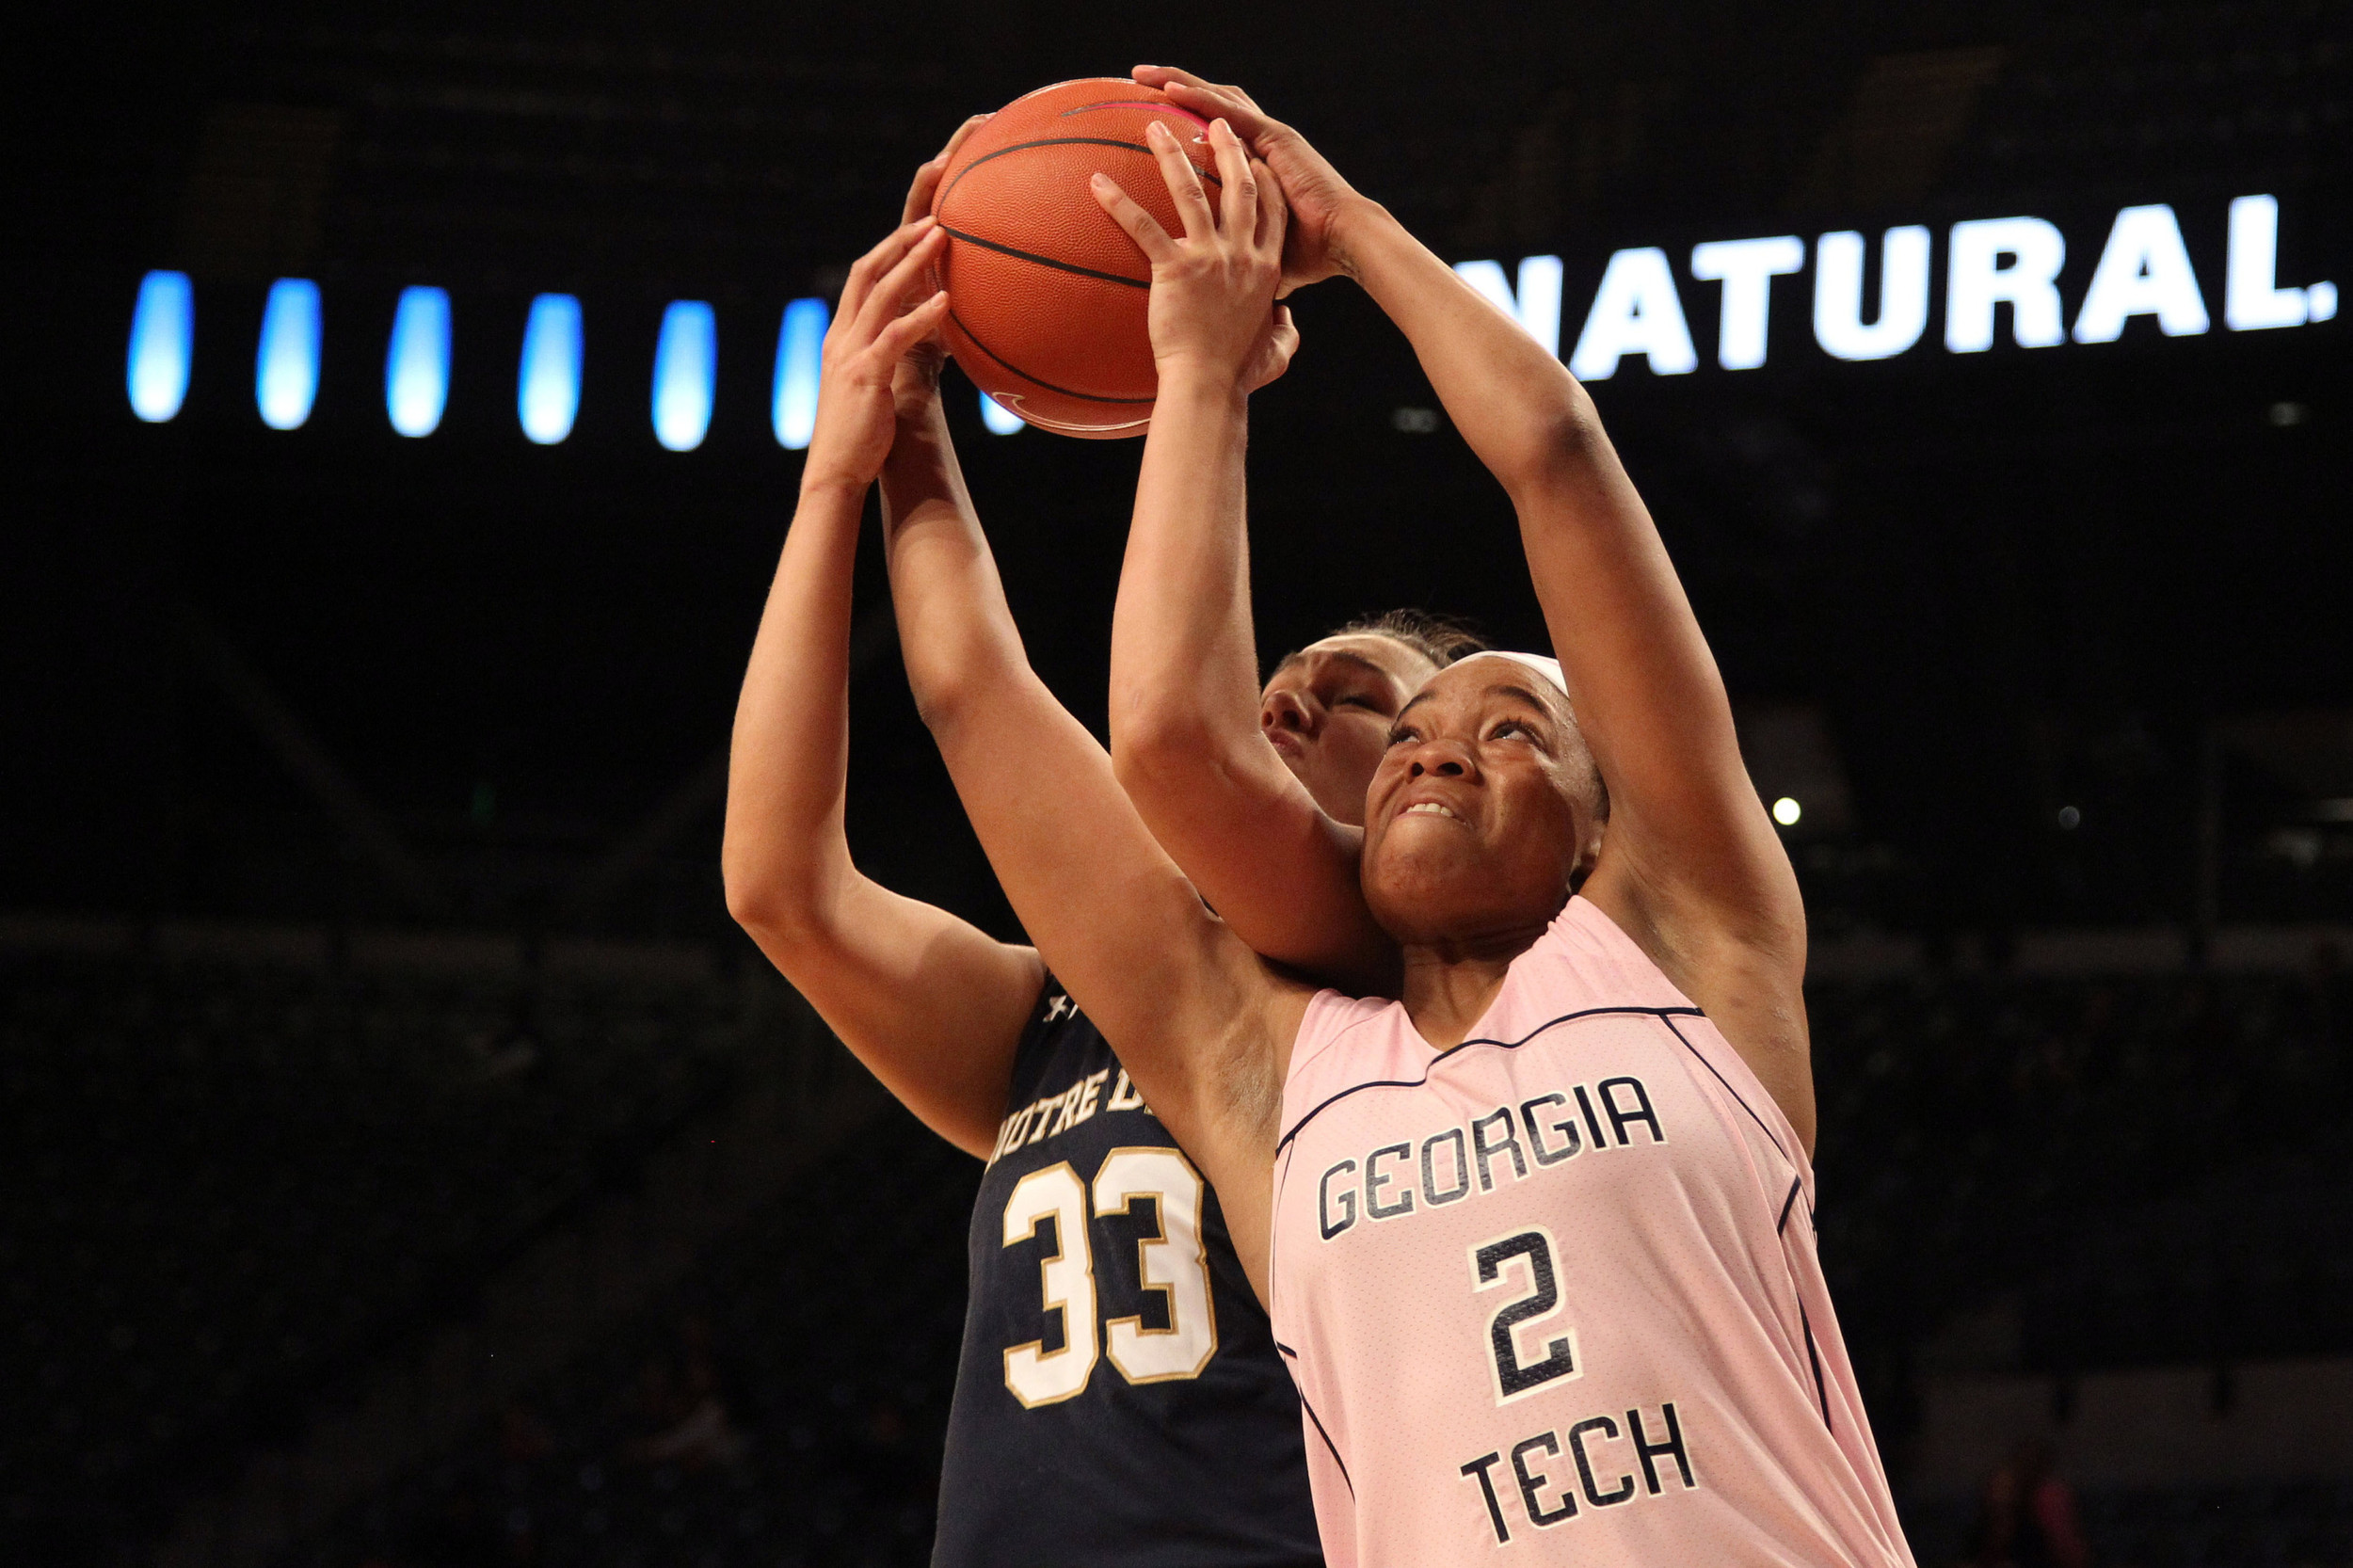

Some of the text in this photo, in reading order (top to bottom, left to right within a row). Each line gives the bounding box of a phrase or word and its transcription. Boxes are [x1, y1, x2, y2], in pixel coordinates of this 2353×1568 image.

[1450, 194, 2338, 381] NATURAL.
[984, 1067, 1110, 1175] NOTRE
[1318, 1075, 1668, 1241] GEORGIA
[1002, 1145, 1219, 1410] 33
[1466, 1224, 1584, 1407] 2
[1459, 1400, 1699, 1547] TECH
